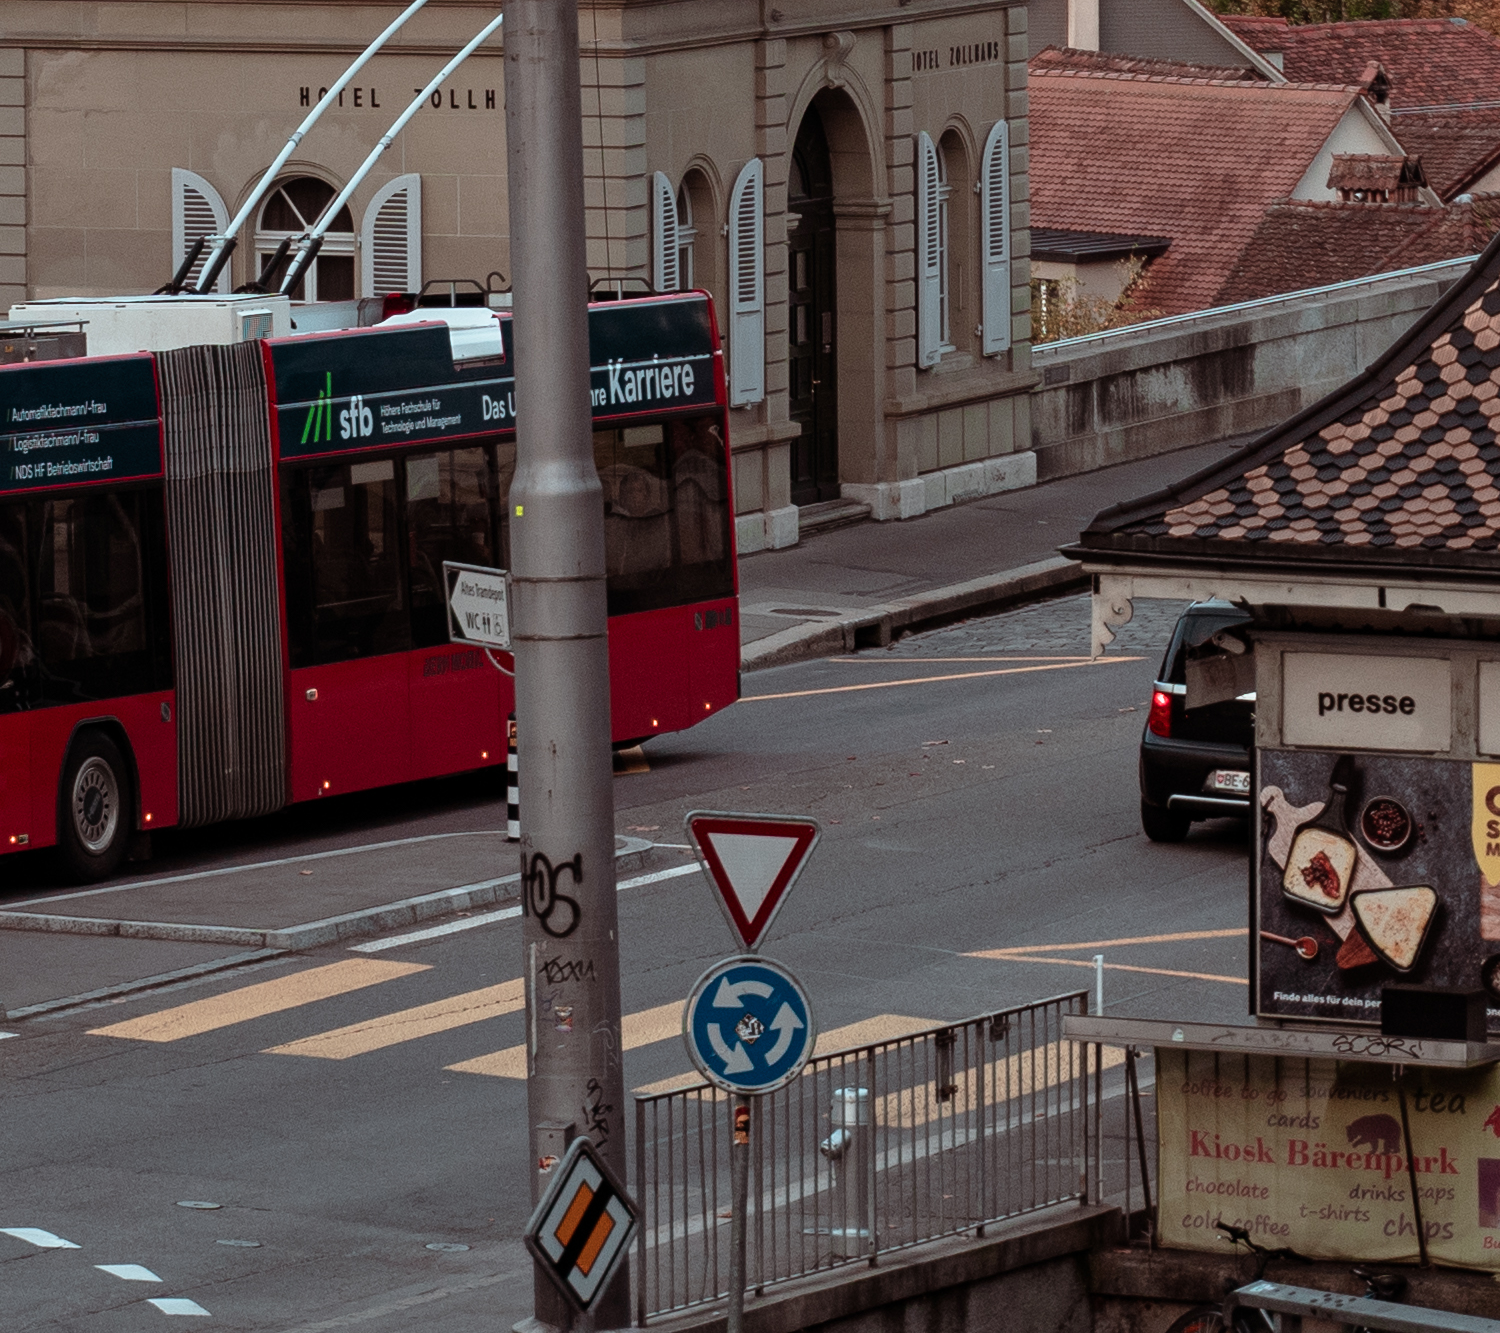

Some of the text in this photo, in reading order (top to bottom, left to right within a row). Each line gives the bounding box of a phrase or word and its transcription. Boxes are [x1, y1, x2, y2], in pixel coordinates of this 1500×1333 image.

[950, 41, 999, 67] ZOLLHAUS
[608, 353, 695, 405] Karriere
[339, 394, 374, 440] sfb
[482, 394, 507, 421] Das
[415, 416, 426, 430] und
[465, 611, 481, 631] WC
[1317, 690, 1416, 717] presse
[1273, 991, 1300, 1003] Finde
[1301, 993, 1326, 1005] alles
[1325, 993, 1343, 1006] für
[1342, 995, 1364, 1007] dein
[1181, 1079, 1288, 1107] coffee to go
[1413, 1084, 1466, 1116] tea
[1267, 1111, 1321, 1130] cards
[1189, 1128, 1276, 1165] Kiosk
[1185, 1176, 1270, 1202] chocolate
[1348, 1183, 1406, 1203] drinks
[1182, 1209, 1224, 1230] cold
[1299, 1200, 1372, 1223] t-shirts
[1383, 1212, 1455, 1245] chps
